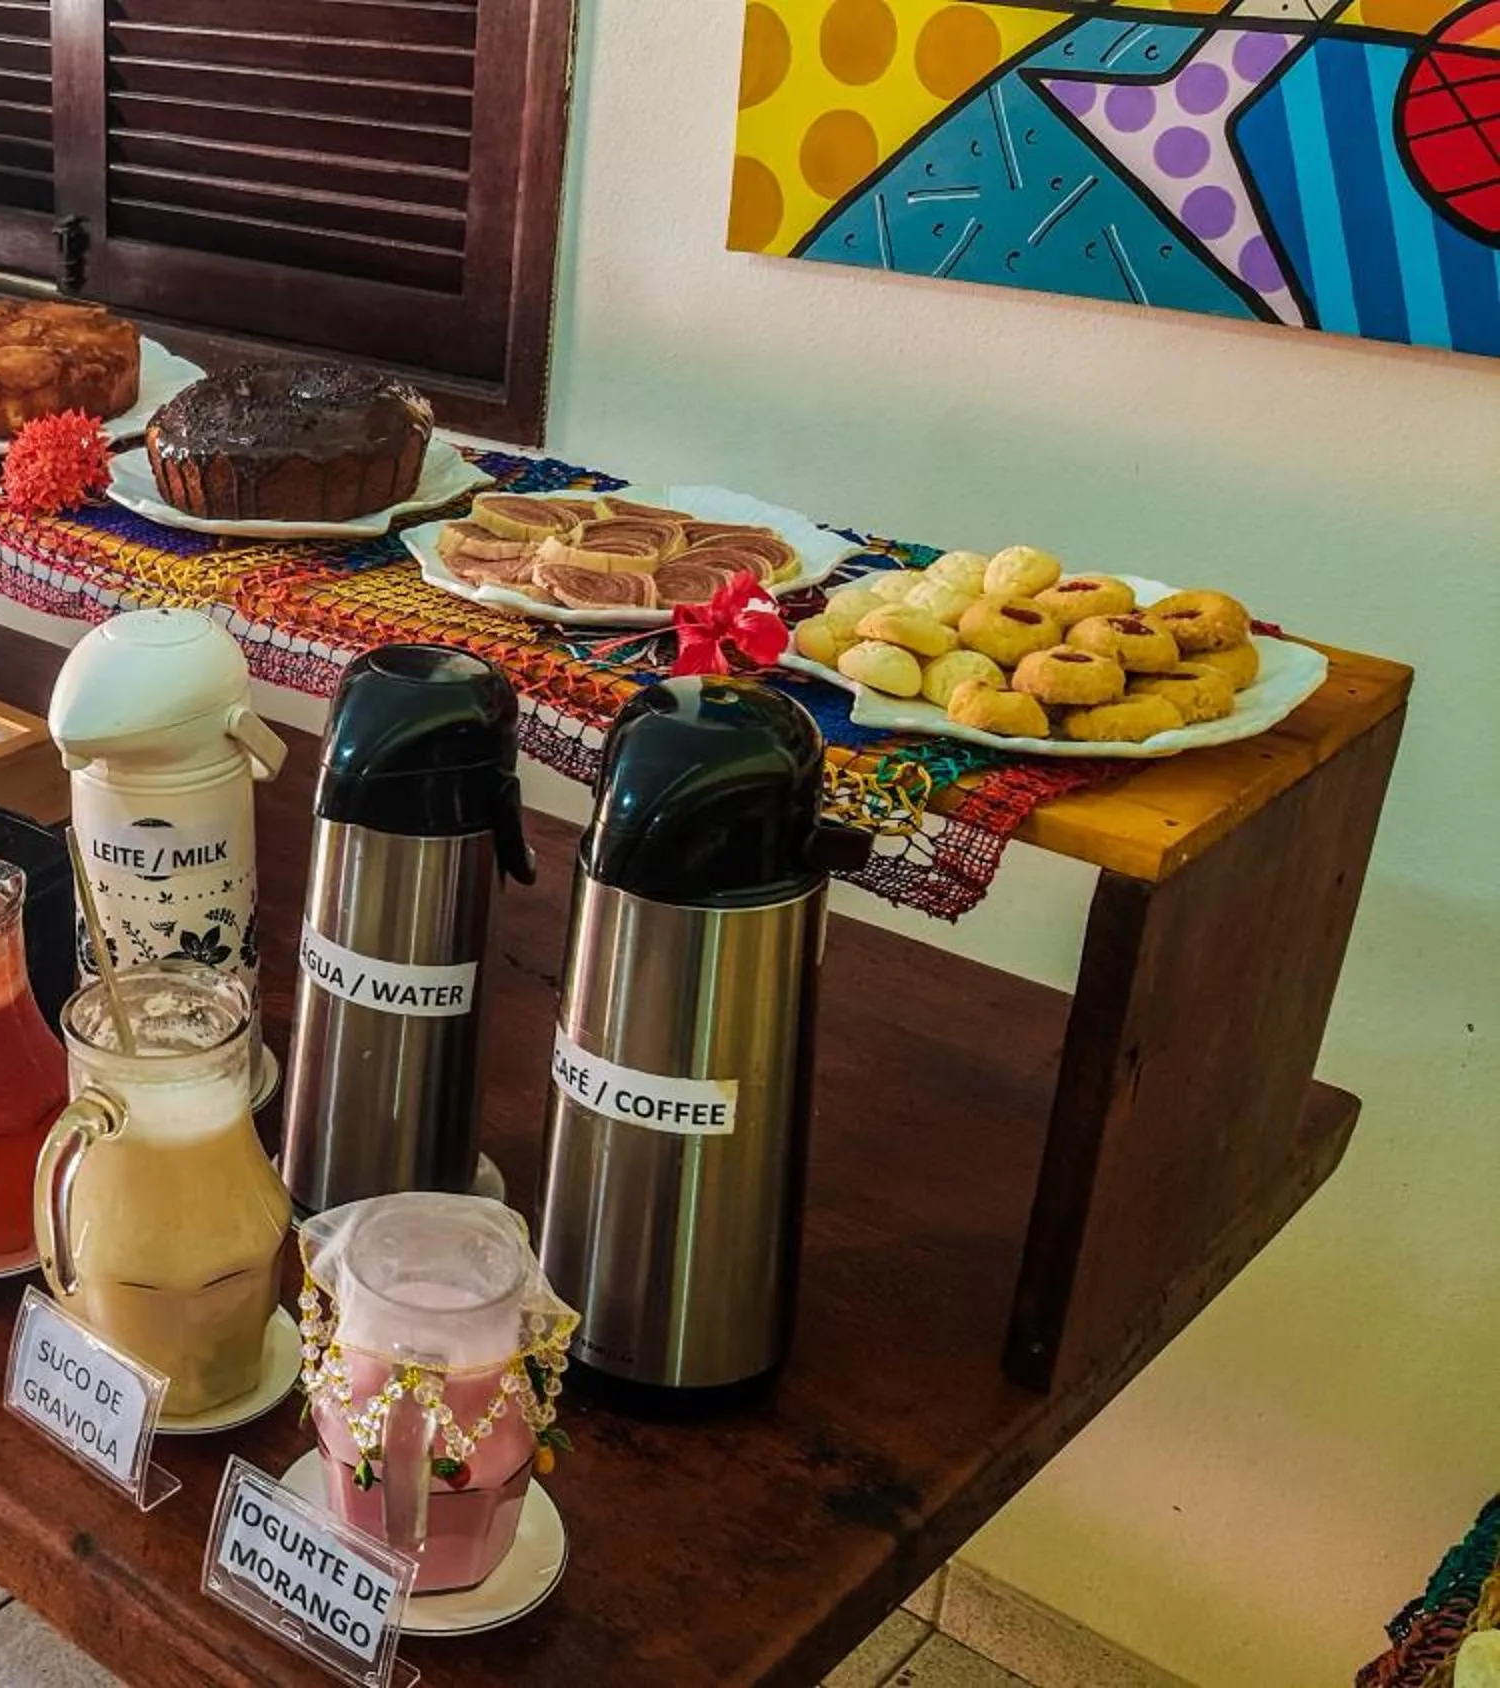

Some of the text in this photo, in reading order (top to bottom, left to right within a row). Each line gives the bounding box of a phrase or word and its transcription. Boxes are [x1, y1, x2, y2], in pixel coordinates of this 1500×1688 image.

[93, 839, 227, 873] LEITE / MILK
[349, 973, 365, 997] /
[371, 979, 464, 1007] WATER
[594, 1080, 608, 1106] /
[614, 1090, 727, 1126] COFFEE
[37, 1339, 125, 1416] SUCO DE
[23, 1378, 118, 1465] GRAVIOLA
[233, 1494, 391, 1615] IOGURTE DE
[229, 1539, 371, 1649] MORANGO
